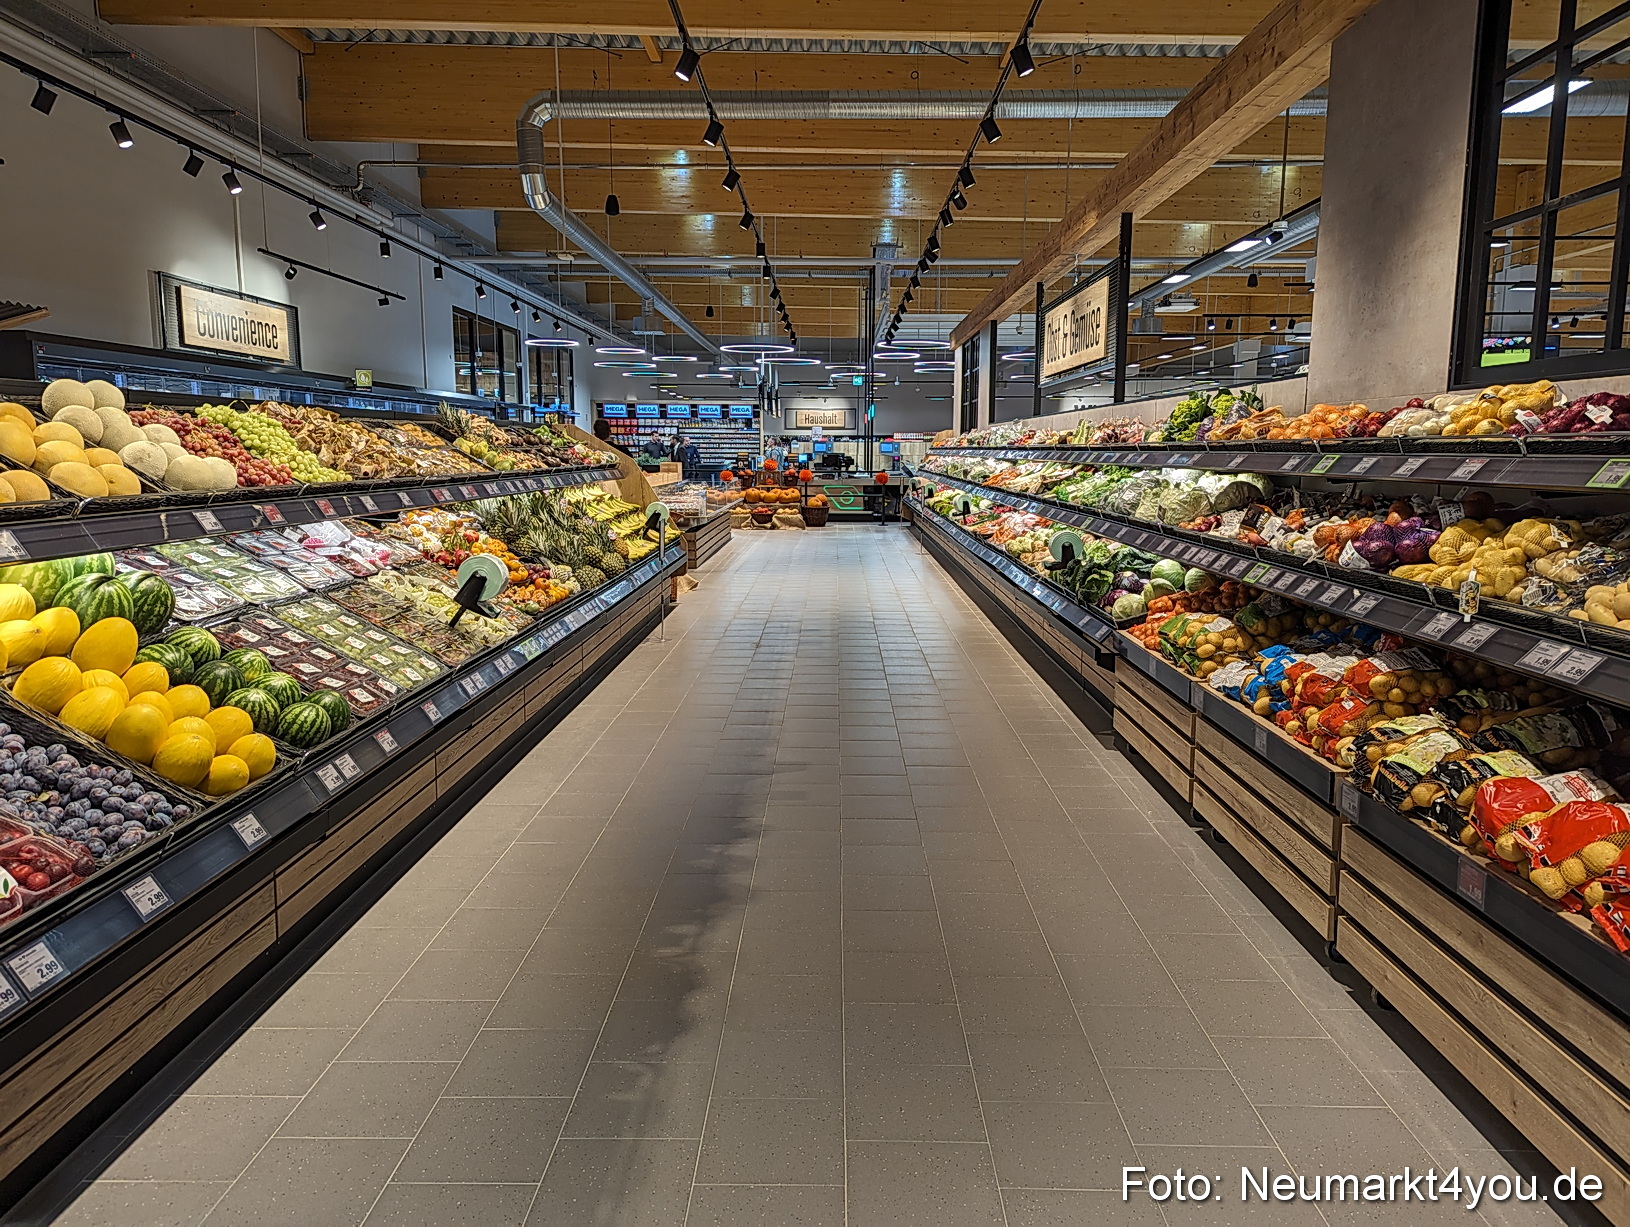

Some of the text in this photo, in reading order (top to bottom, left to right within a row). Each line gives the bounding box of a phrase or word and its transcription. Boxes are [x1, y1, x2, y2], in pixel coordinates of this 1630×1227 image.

[195, 300, 279, 350] Convenience
[1069, 300, 1100, 355] Gemüse
[804, 413, 838, 425] Haushalt
[1566, 666, 1586, 676] 2.99
[251, 826, 264, 838] 2.99
[148, 891, 165, 906] 2.99
[37, 960, 59, 979] 2.99
